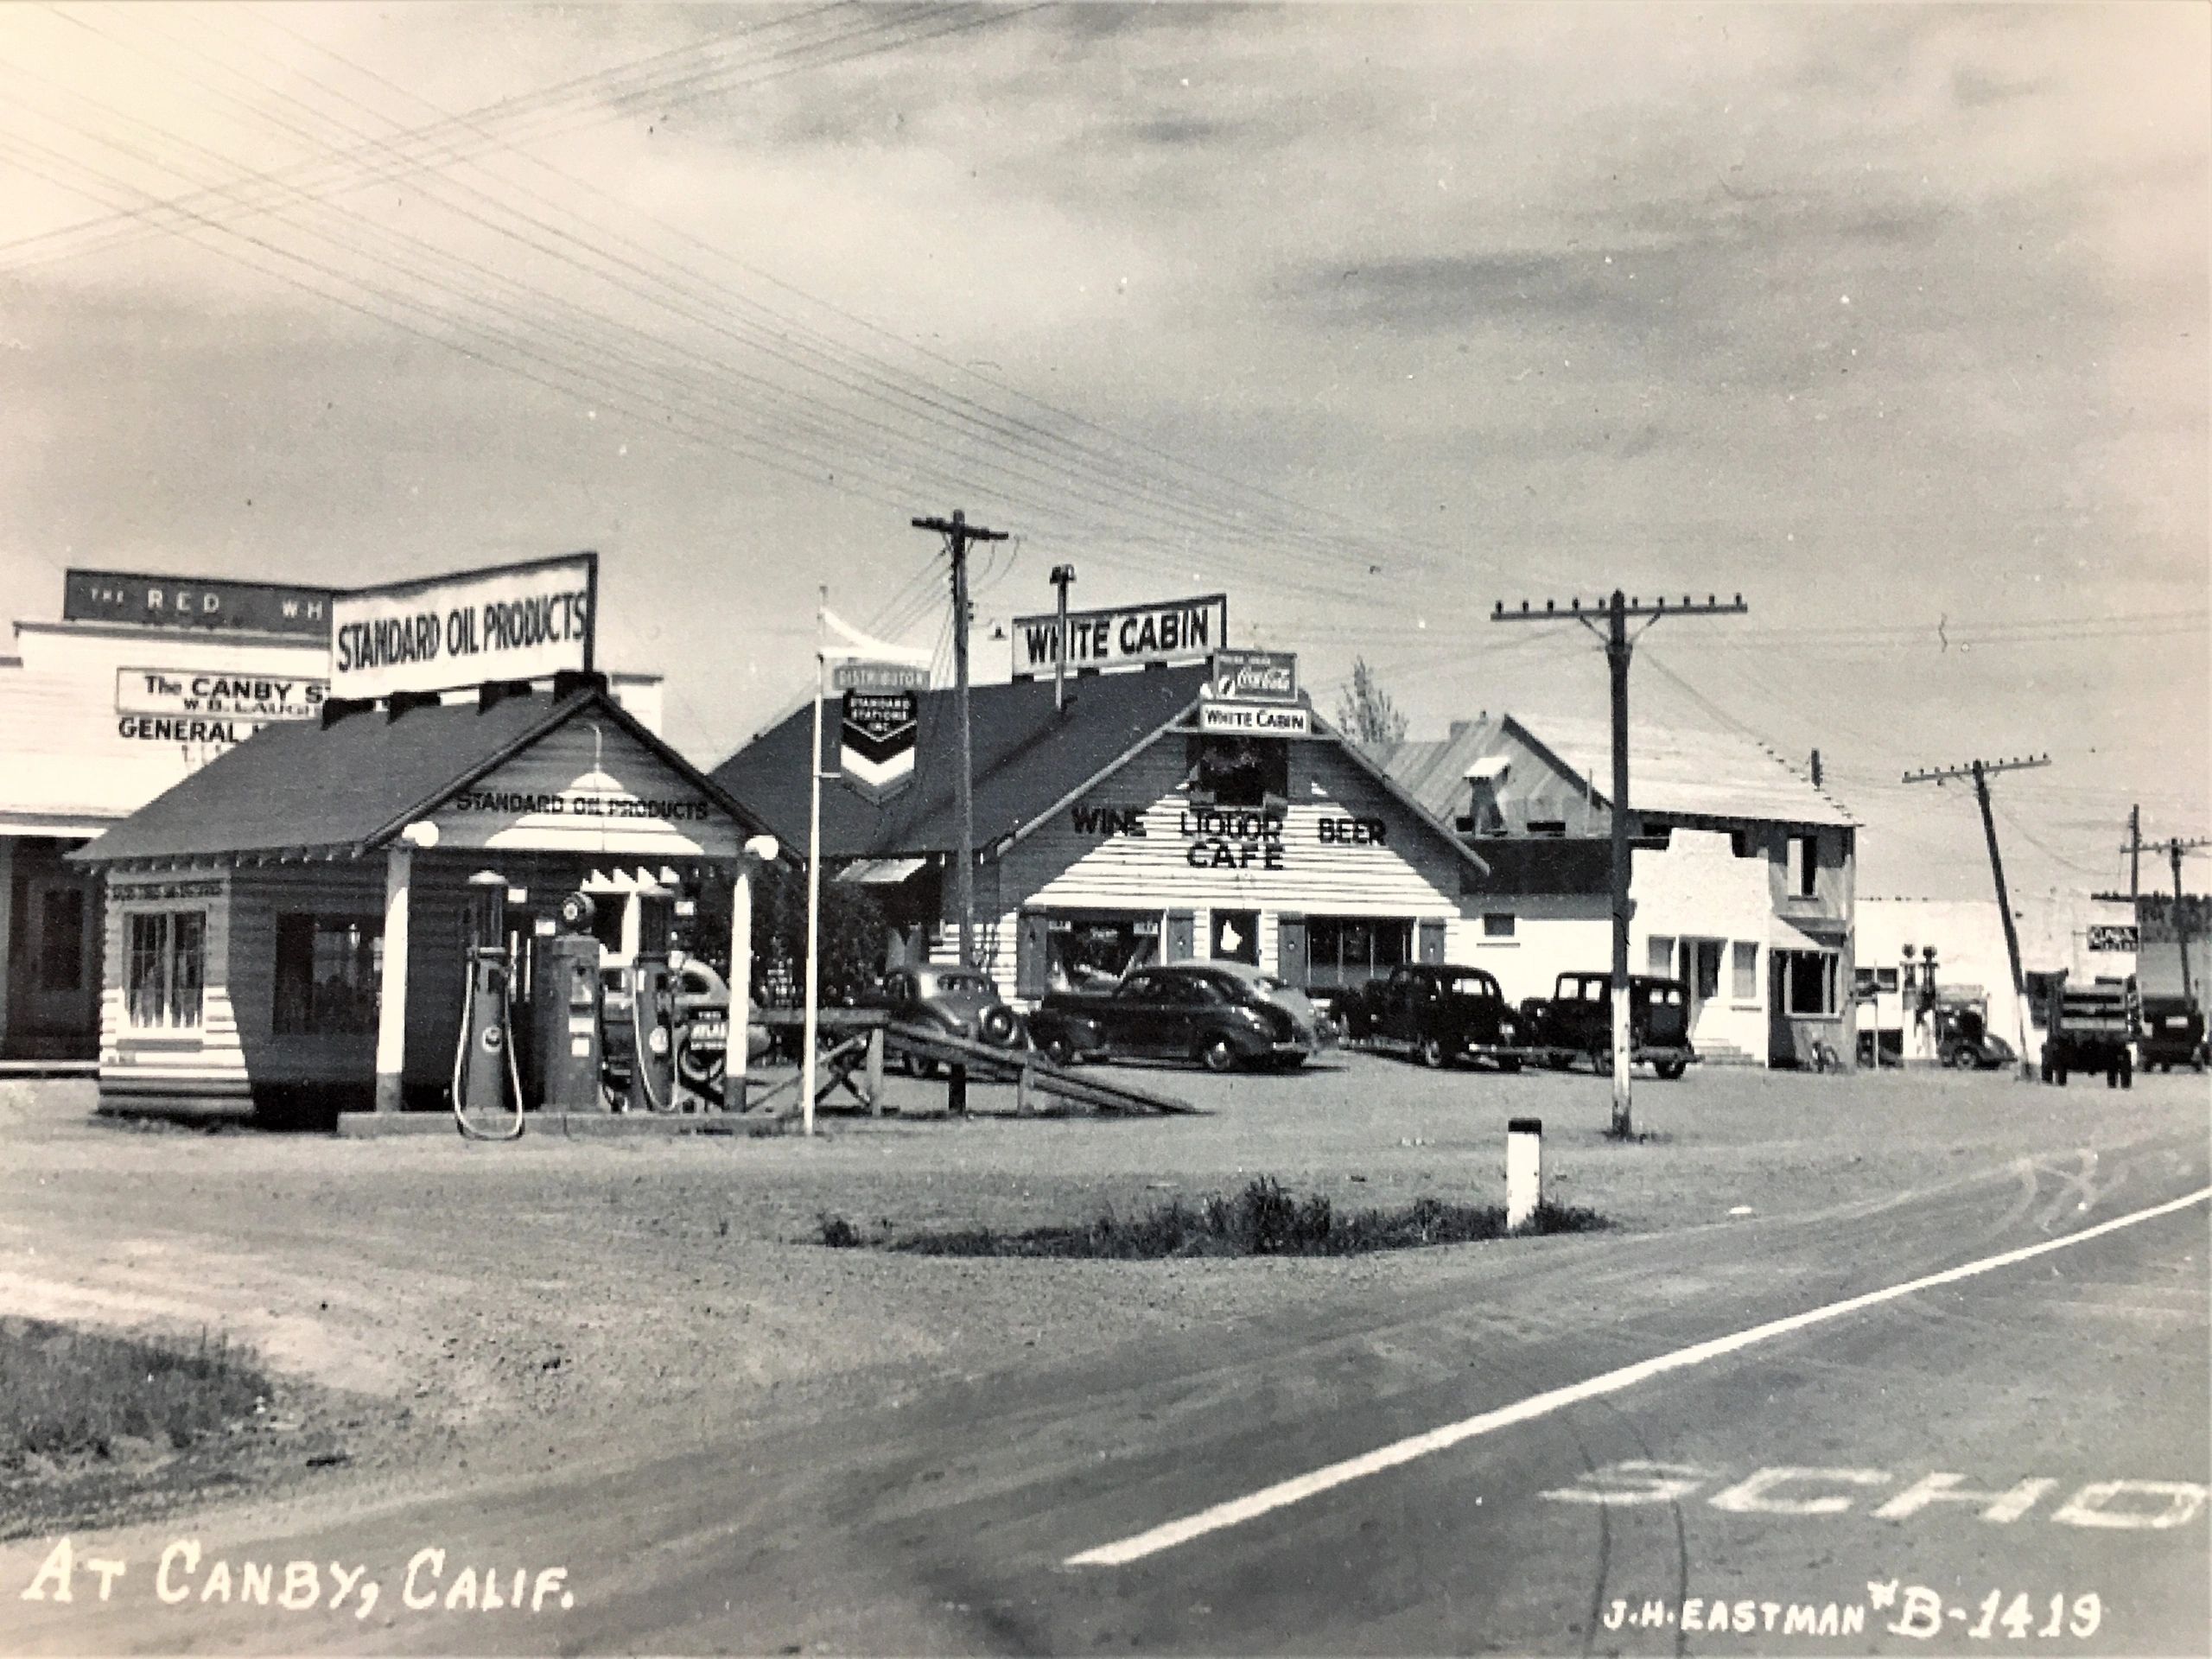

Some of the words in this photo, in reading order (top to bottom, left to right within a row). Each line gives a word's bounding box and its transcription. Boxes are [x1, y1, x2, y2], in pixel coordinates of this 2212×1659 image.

[147, 588, 219, 613] RED
[338, 610, 441, 673] STANDARD
[447, 606, 480, 657] OIL
[484, 590, 587, 652] PRODUCTS
[1026, 620, 1110, 664] WHITE
[1119, 606, 1209, 655] CABIN
[145, 675, 182, 693] The
[192, 677, 293, 702] CANBY
[305, 685, 331, 703] S
[118, 717, 239, 743] GENERAL
[1206, 709, 1253, 727] WHITE
[1256, 709, 1304, 729] CABIN
[457, 791, 563, 814] STANDARD
[574, 796, 602, 816] OIL
[608, 798, 708, 821] PRODUCTS
[1071, 806, 1147, 837] WINE
[1180, 810, 1284, 838] LIQUOR
[1319, 817, 1386, 846] BEER
[1187, 840, 1284, 870] CAFE
[1539, 1459, 2210, 1529] SCHO
